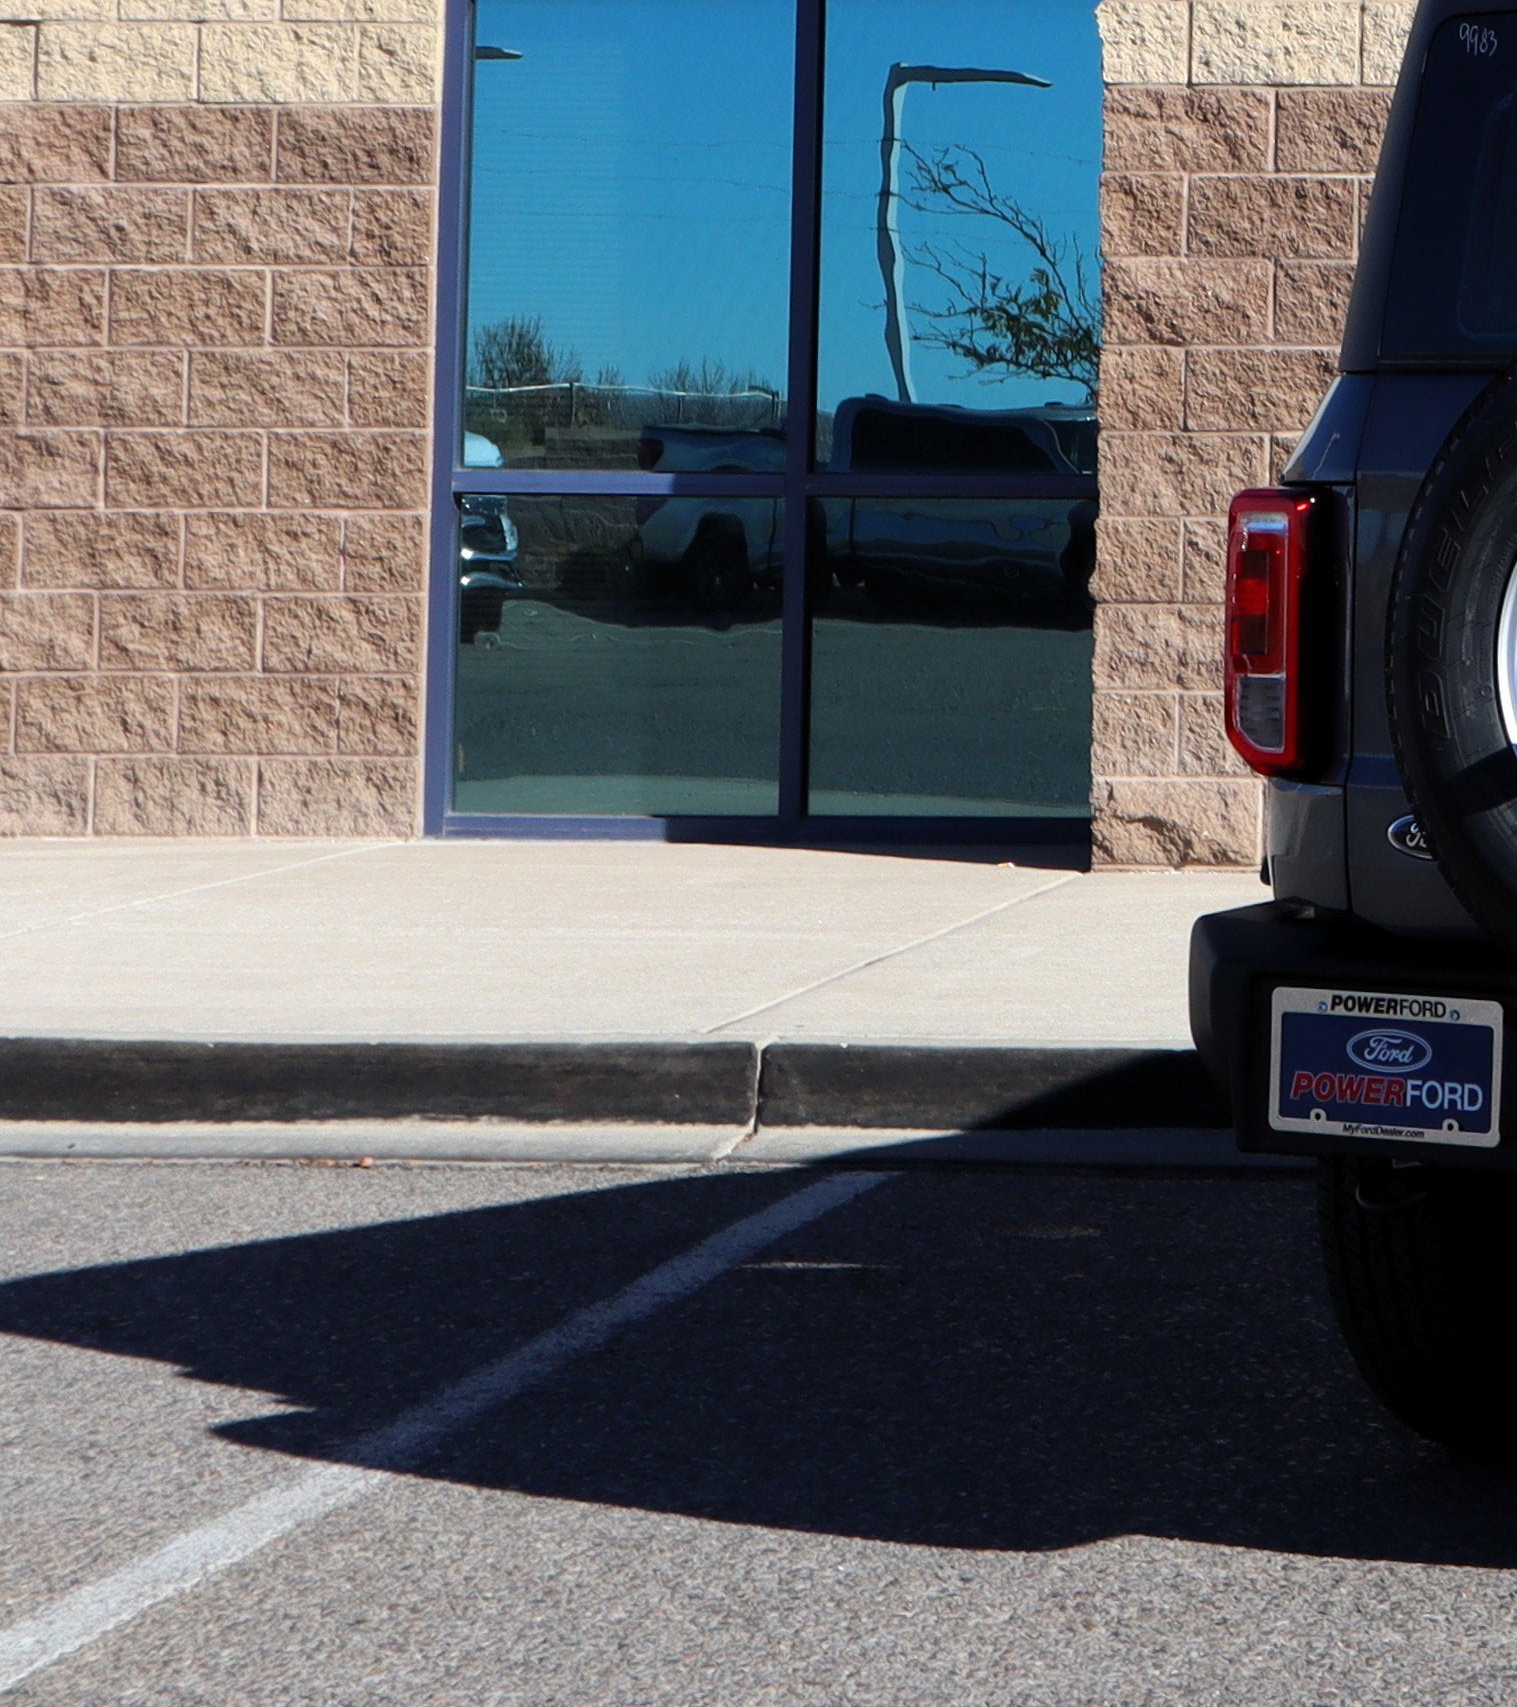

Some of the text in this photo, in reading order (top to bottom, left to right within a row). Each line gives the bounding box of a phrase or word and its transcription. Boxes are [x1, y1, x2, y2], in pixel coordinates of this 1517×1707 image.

[1458, 22, 1499, 58] 9983
[1330, 994, 1447, 1019] POWERFORD
[1363, 1035, 1414, 1064] Ford
[1290, 1071, 1483, 1112] POWERFORD
